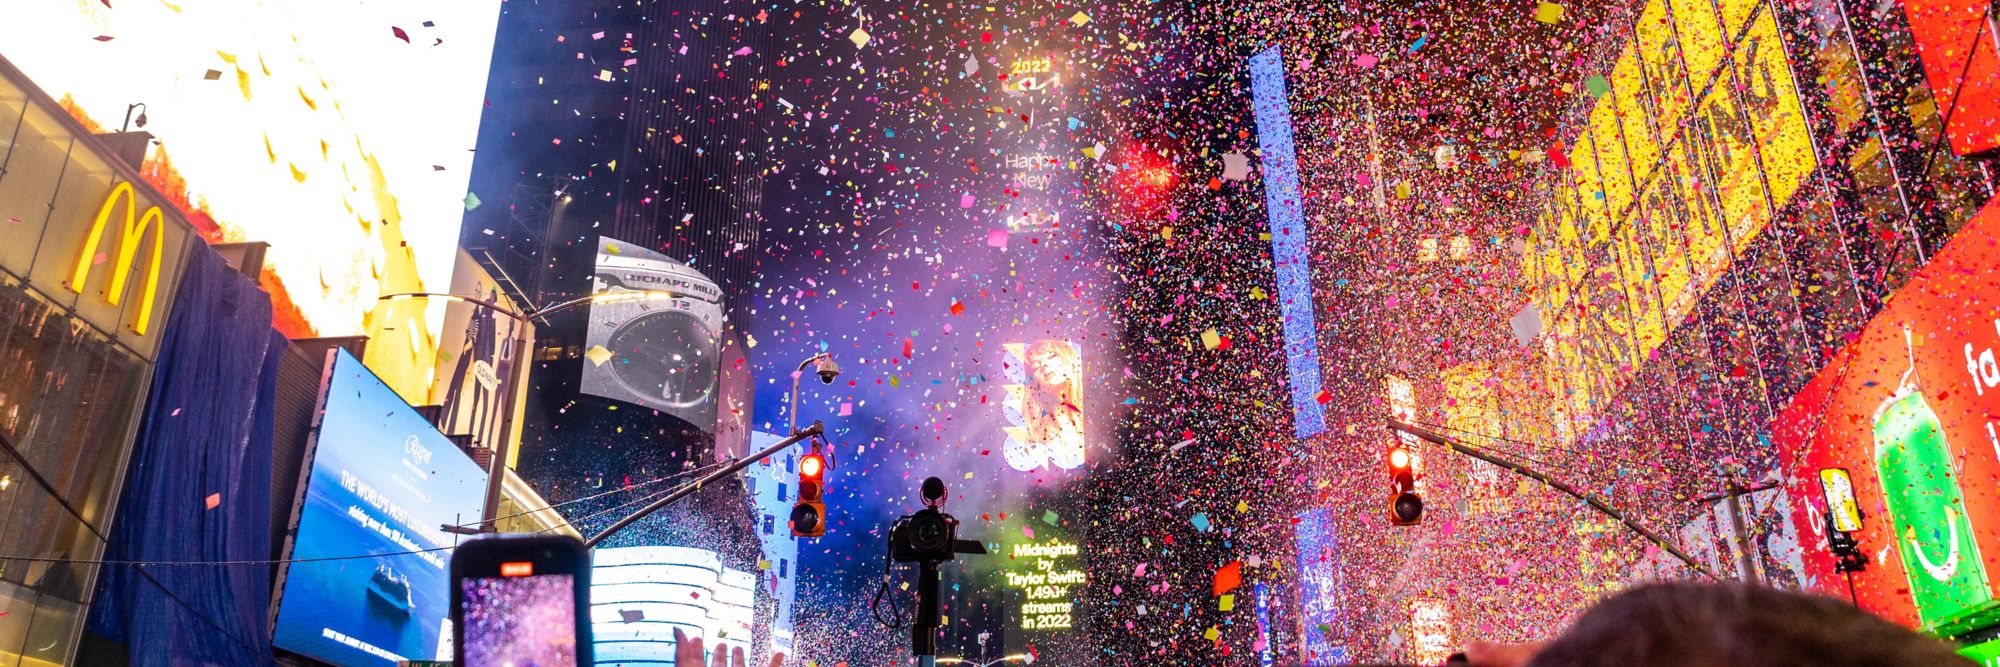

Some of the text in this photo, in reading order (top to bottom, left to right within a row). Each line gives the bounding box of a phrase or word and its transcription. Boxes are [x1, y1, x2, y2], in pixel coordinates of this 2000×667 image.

[1013, 173, 1051, 188] New
[624, 274, 718, 296] RICHARD MILLE
[671, 300, 690, 311] 12
[340, 469, 357, 493] THE
[357, 479, 389, 513] WORLD'S
[388, 502, 408, 525] MOST
[1014, 543, 1078, 558] Midnights
[1037, 557, 1054, 572] by
[1006, 570, 1086, 588] Taylor Swift:
[1022, 602, 1072, 614] streams
[1022, 614, 1072, 629] in 2022
